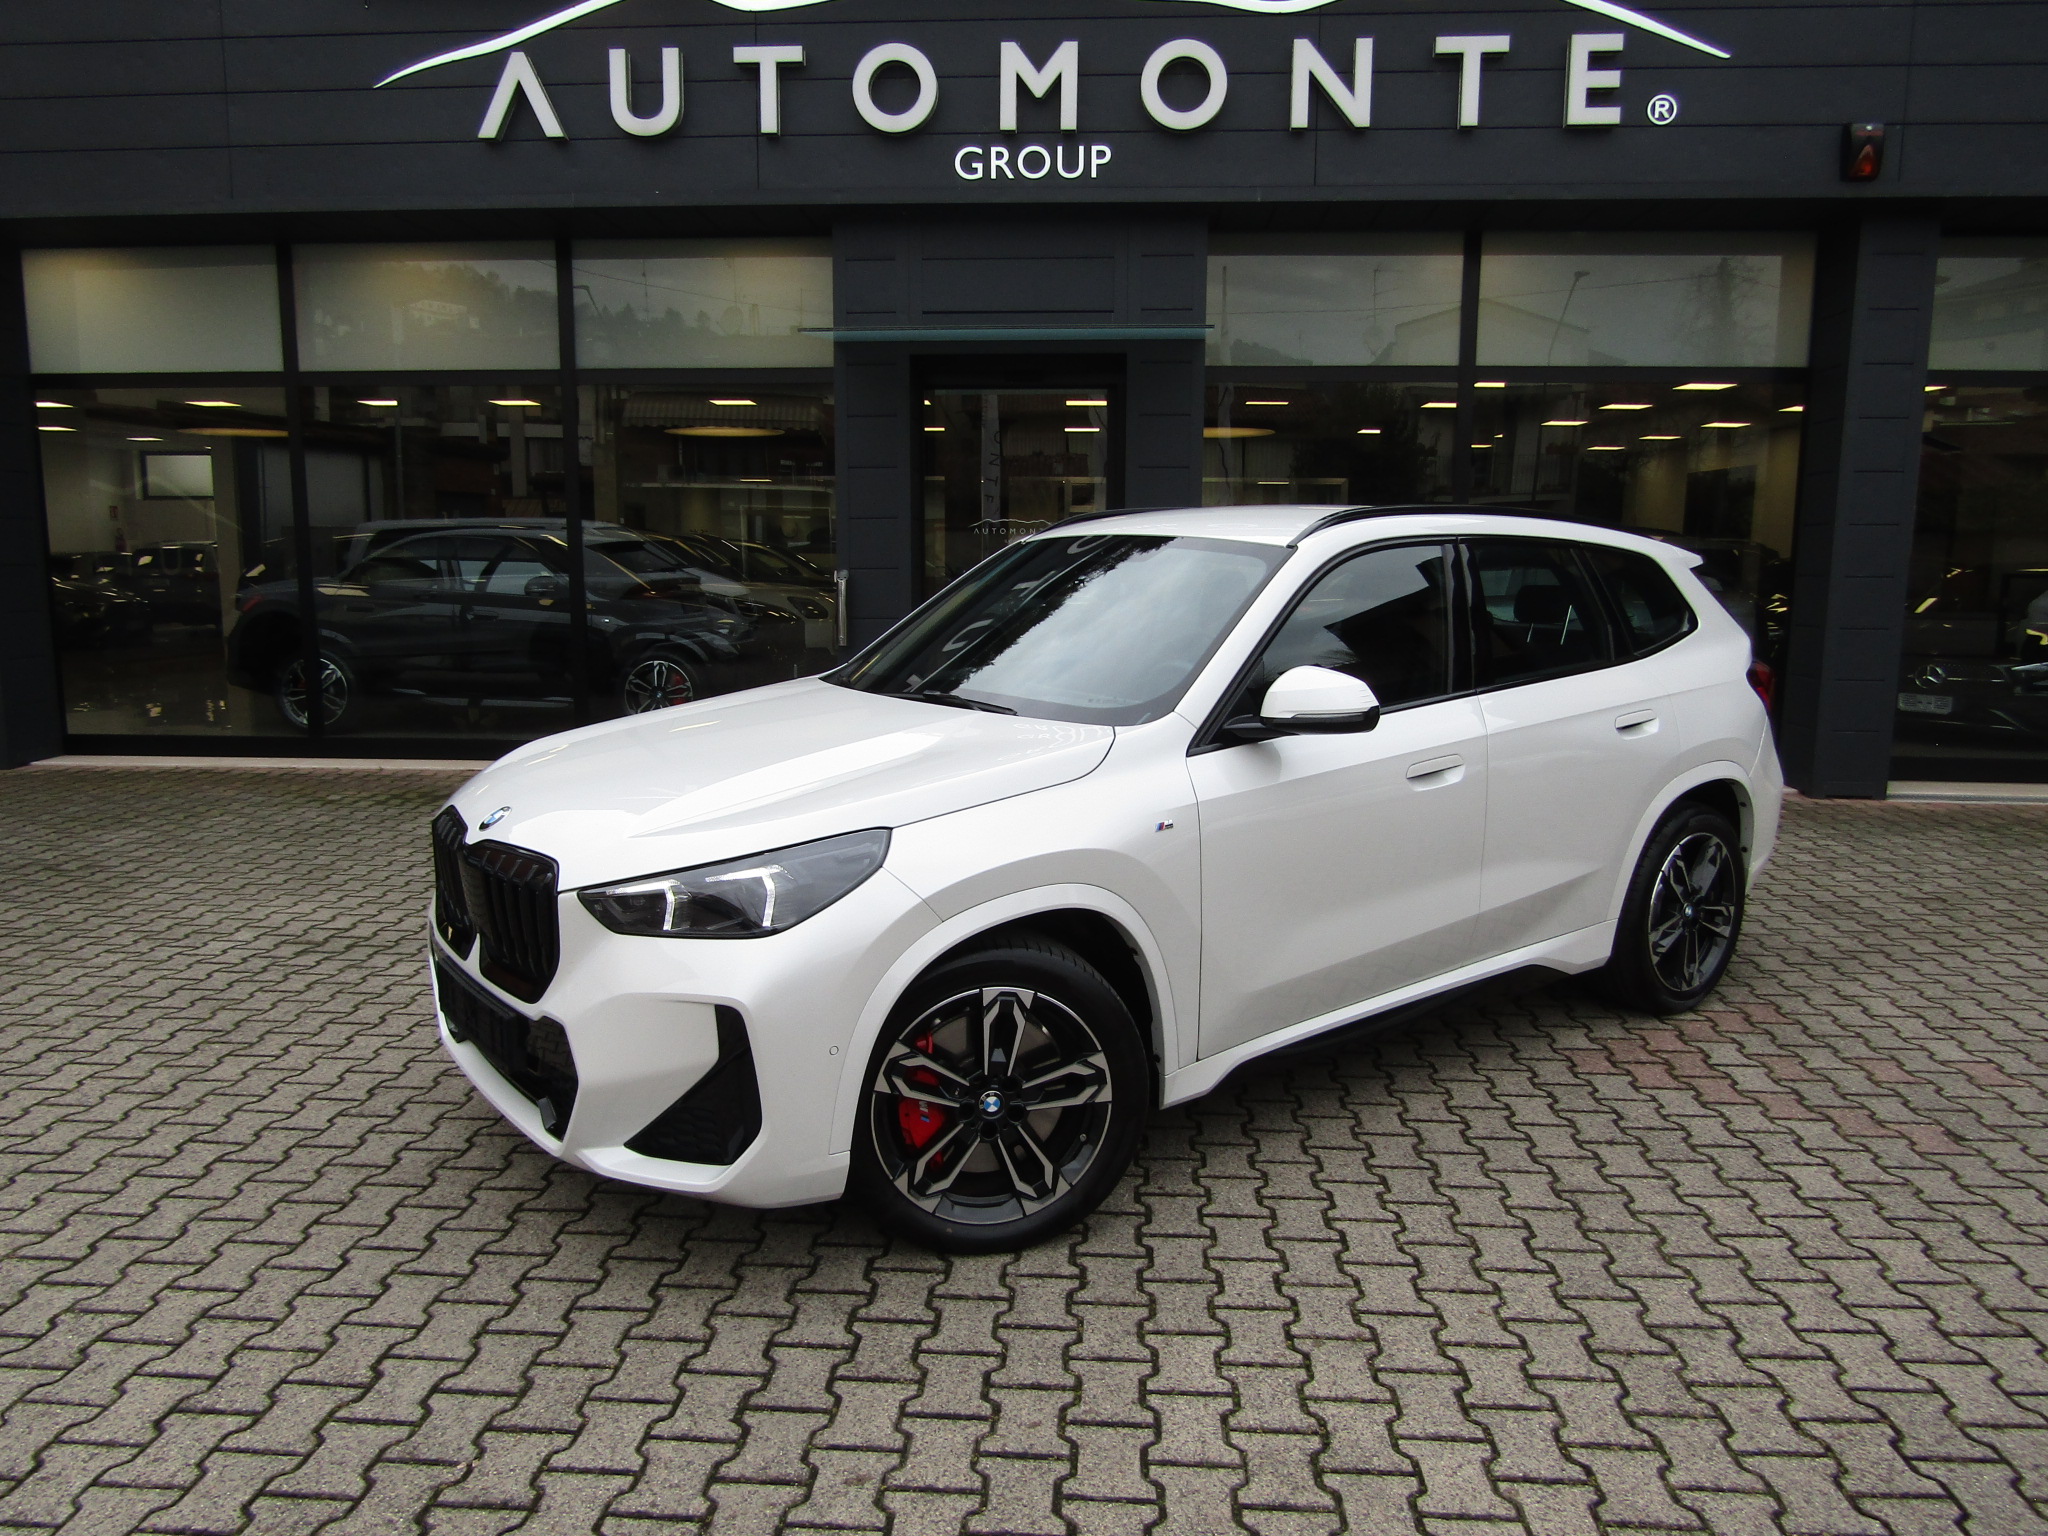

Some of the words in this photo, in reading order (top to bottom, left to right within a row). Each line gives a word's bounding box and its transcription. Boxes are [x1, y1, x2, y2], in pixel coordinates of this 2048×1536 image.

[477, 33, 1625, 140] AUTOMONTE
[954, 145, 1112, 180] GROUP
[973, 527, 1045, 535] AUTOMON
